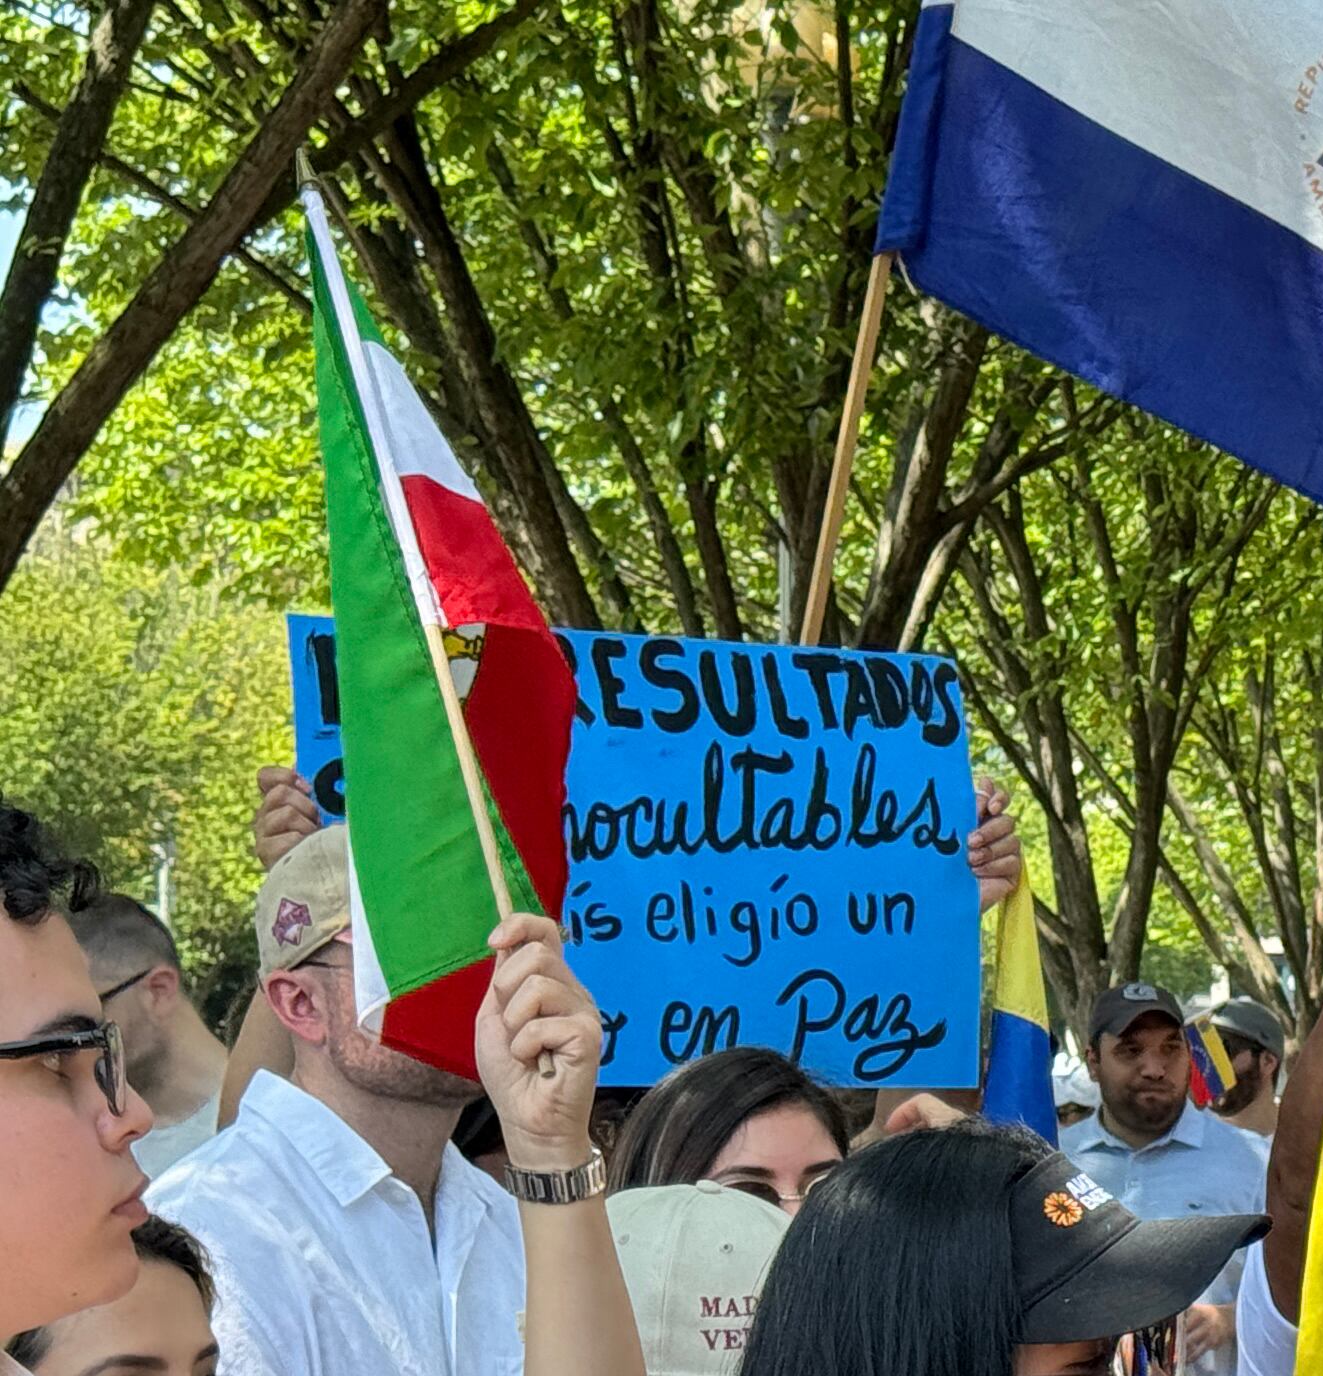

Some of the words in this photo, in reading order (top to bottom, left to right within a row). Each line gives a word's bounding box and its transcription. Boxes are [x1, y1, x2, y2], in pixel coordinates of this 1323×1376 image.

[849, 892, 915, 936] un
[660, 1001, 740, 1065] en
[777, 968, 947, 1082] Paz
